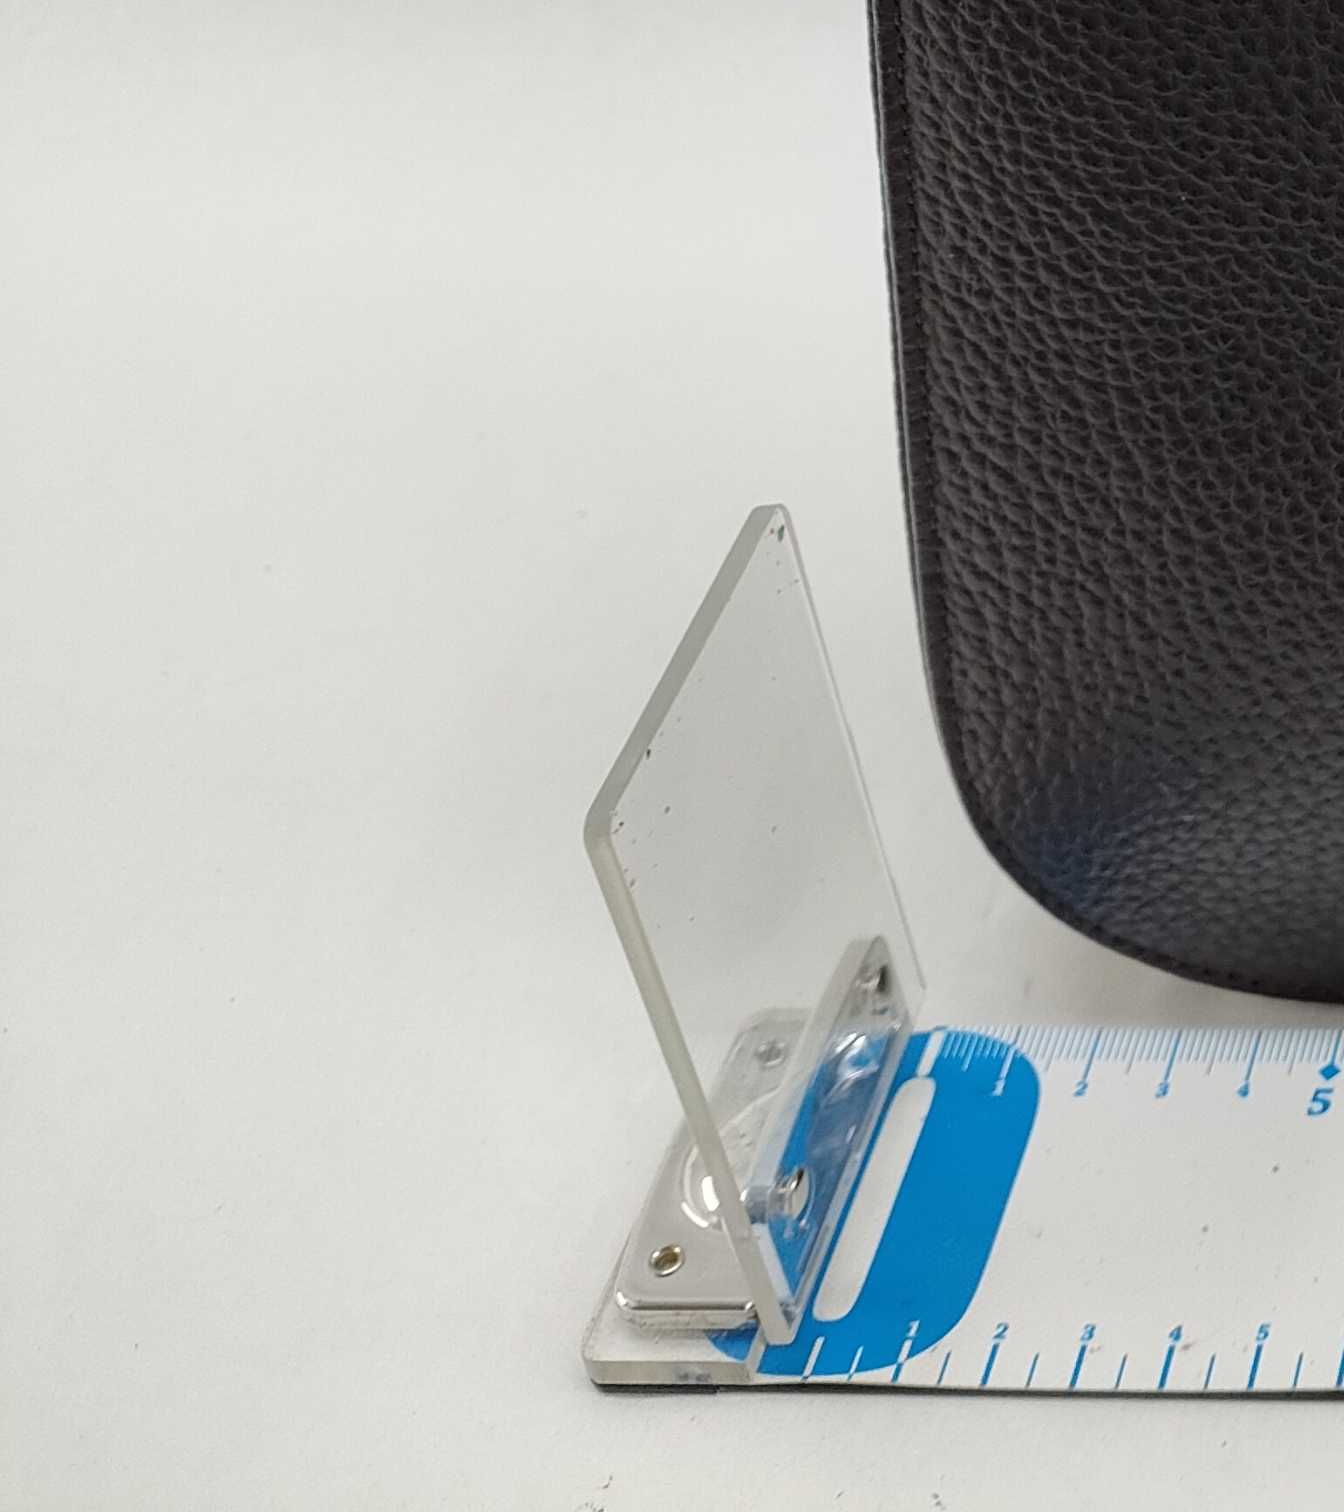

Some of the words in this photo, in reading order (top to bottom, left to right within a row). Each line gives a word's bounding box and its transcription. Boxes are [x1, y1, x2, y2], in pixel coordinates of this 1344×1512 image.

[1074, 1081, 1088, 1096] 2
[1237, 1081, 1250, 1097] 4
[1306, 1088, 1334, 1116] 5
[905, 1321, 921, 1338] 1
[993, 1324, 1009, 1340] 2
[1081, 1324, 1096, 1341] 3
[1169, 1325, 1183, 1341] 4
[1256, 1324, 1271, 1341] 5
